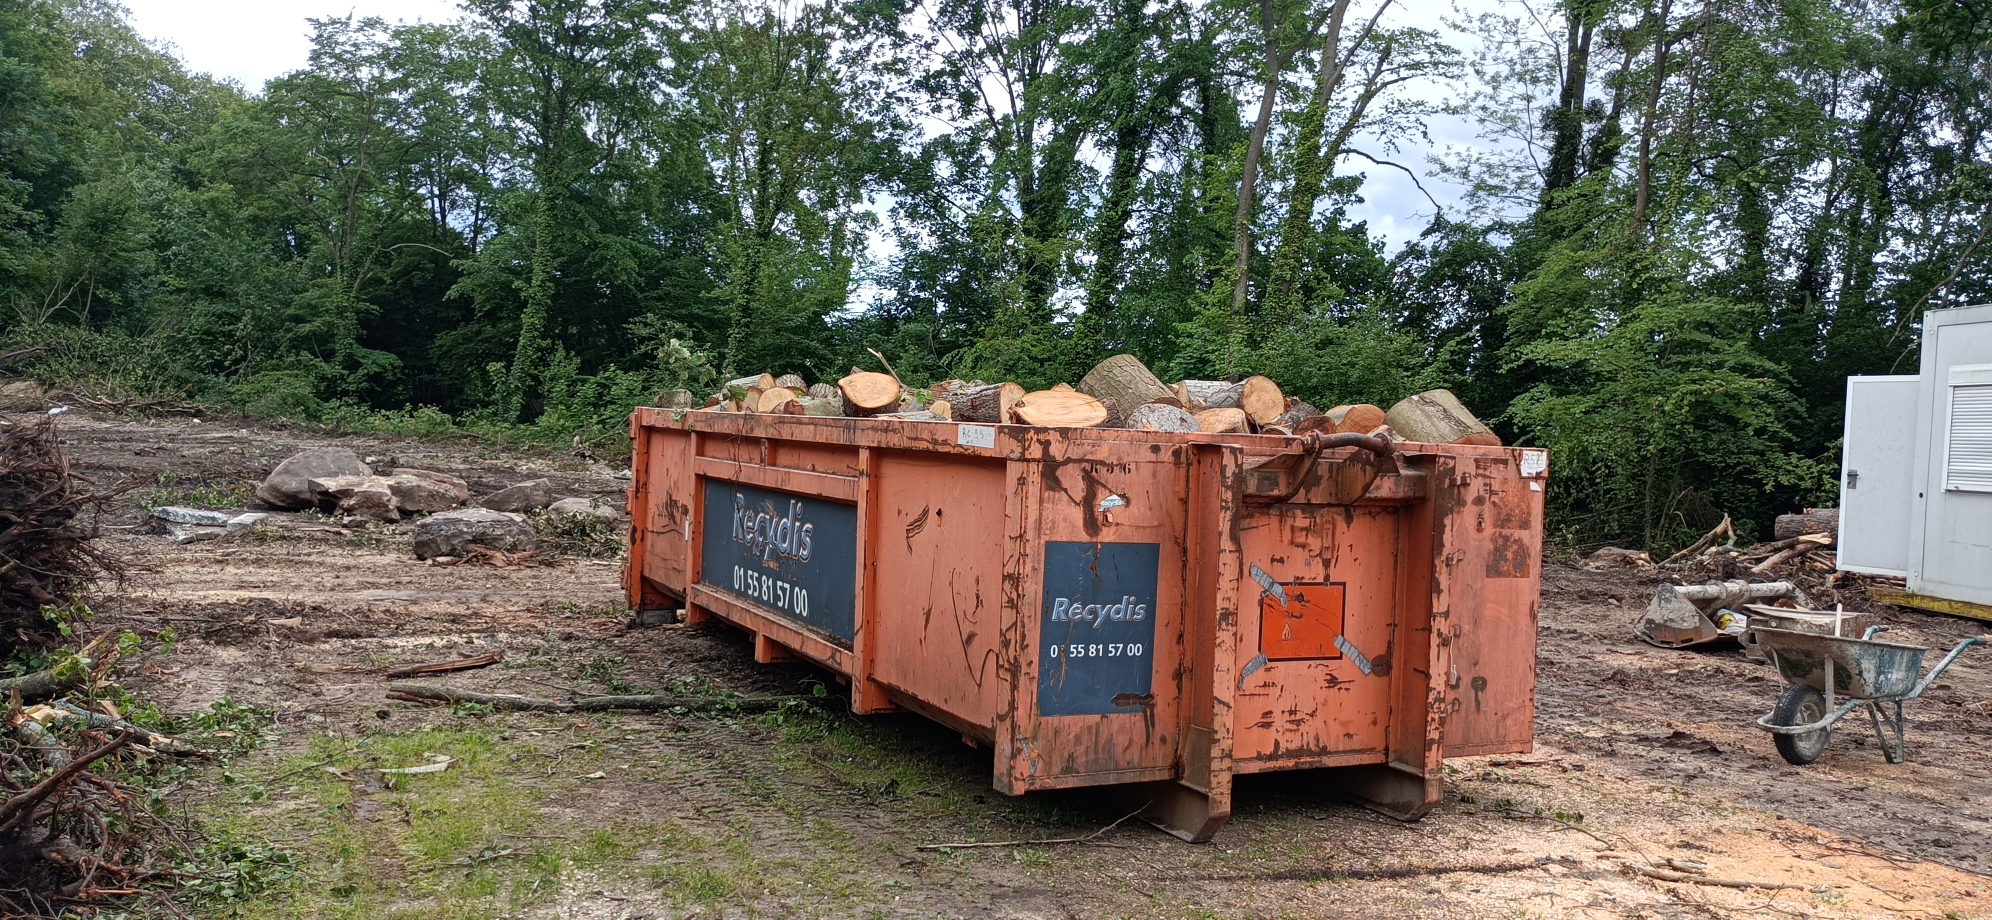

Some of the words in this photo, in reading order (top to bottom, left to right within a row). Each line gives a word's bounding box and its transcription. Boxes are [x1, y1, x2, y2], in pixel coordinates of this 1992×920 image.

[732, 493, 814, 563] Recydis
[733, 565, 744, 592] 01
[747, 569, 759, 597] 55
[761, 575, 774, 604] 81
[776, 580, 790, 610] 57
[793, 586, 808, 617] 00
[1051, 595, 1147, 629] Recydis
[1069, 644, 1085, 657] 55
[1088, 644, 1103, 657] 81
[1107, 643, 1123, 657] 57
[1126, 643, 1143, 657] 00
